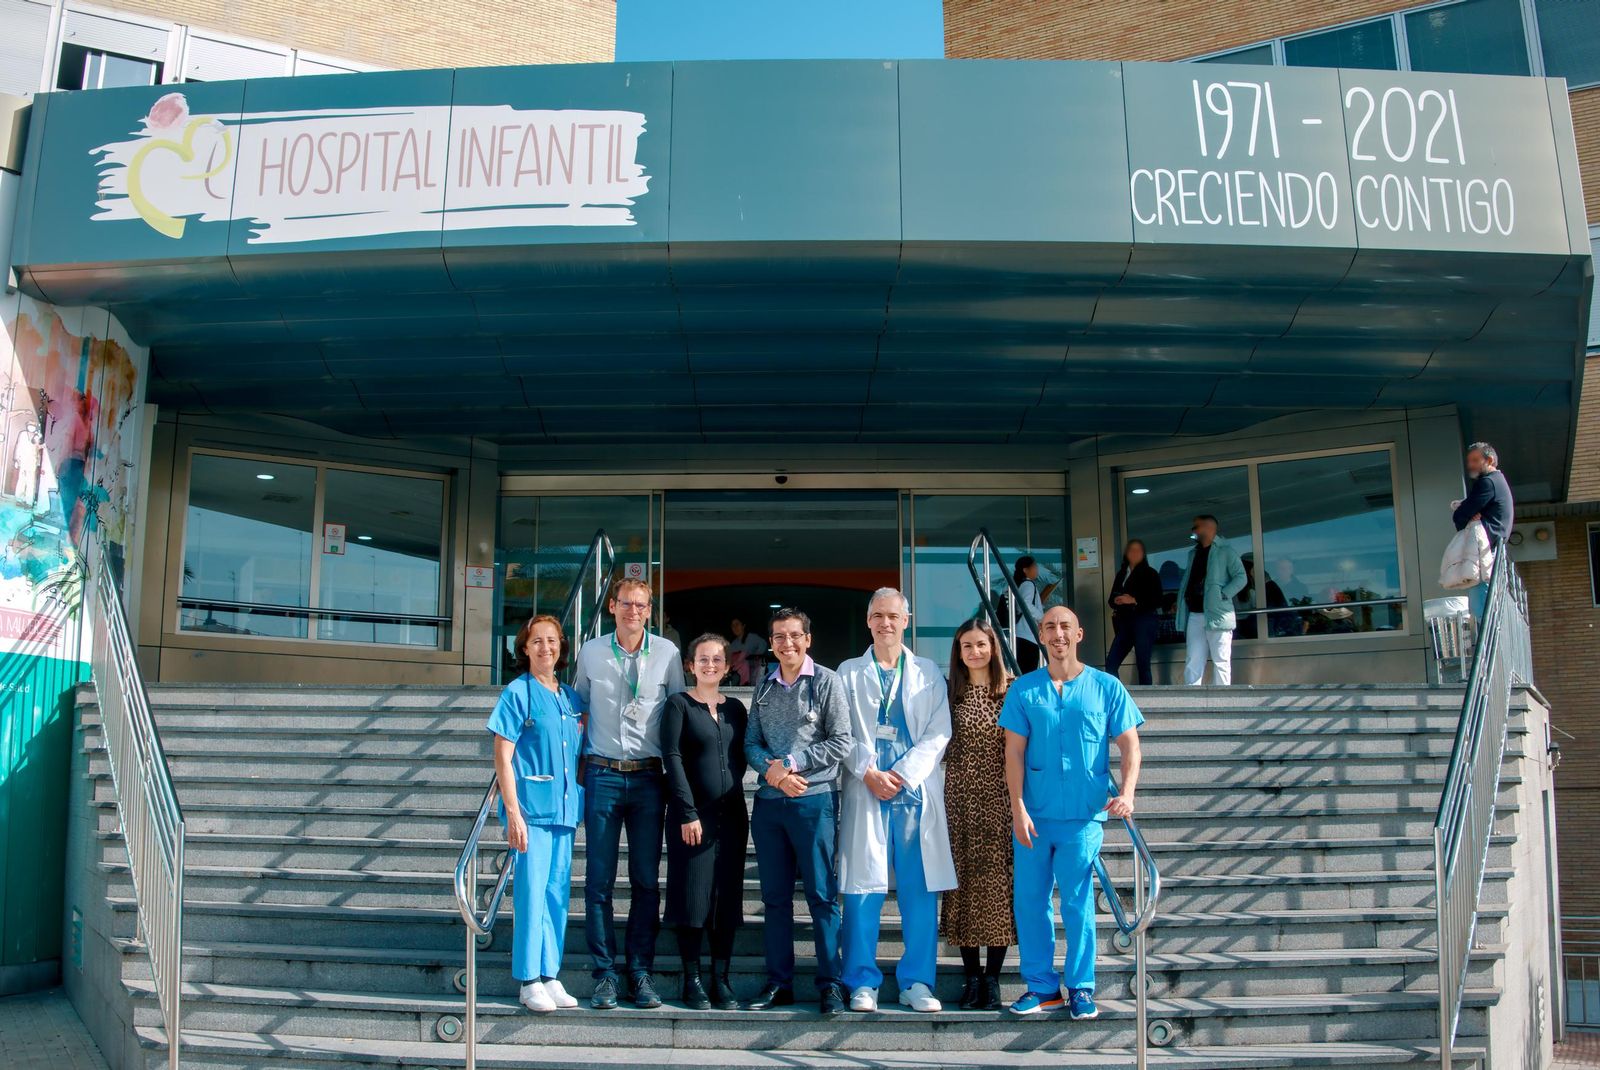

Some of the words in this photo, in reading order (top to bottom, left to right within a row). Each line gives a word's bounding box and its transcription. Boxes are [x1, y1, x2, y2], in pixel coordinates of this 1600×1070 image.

[259, 127, 437, 196] HOSPITAL
[458, 122, 629, 188] INFANTIL
[1192, 79, 1280, 159] 1971
[1345, 86, 1466, 165] 2021
[1130, 168, 1338, 230] CRECIENDO
[1356, 173, 1514, 236] CONTIGO
